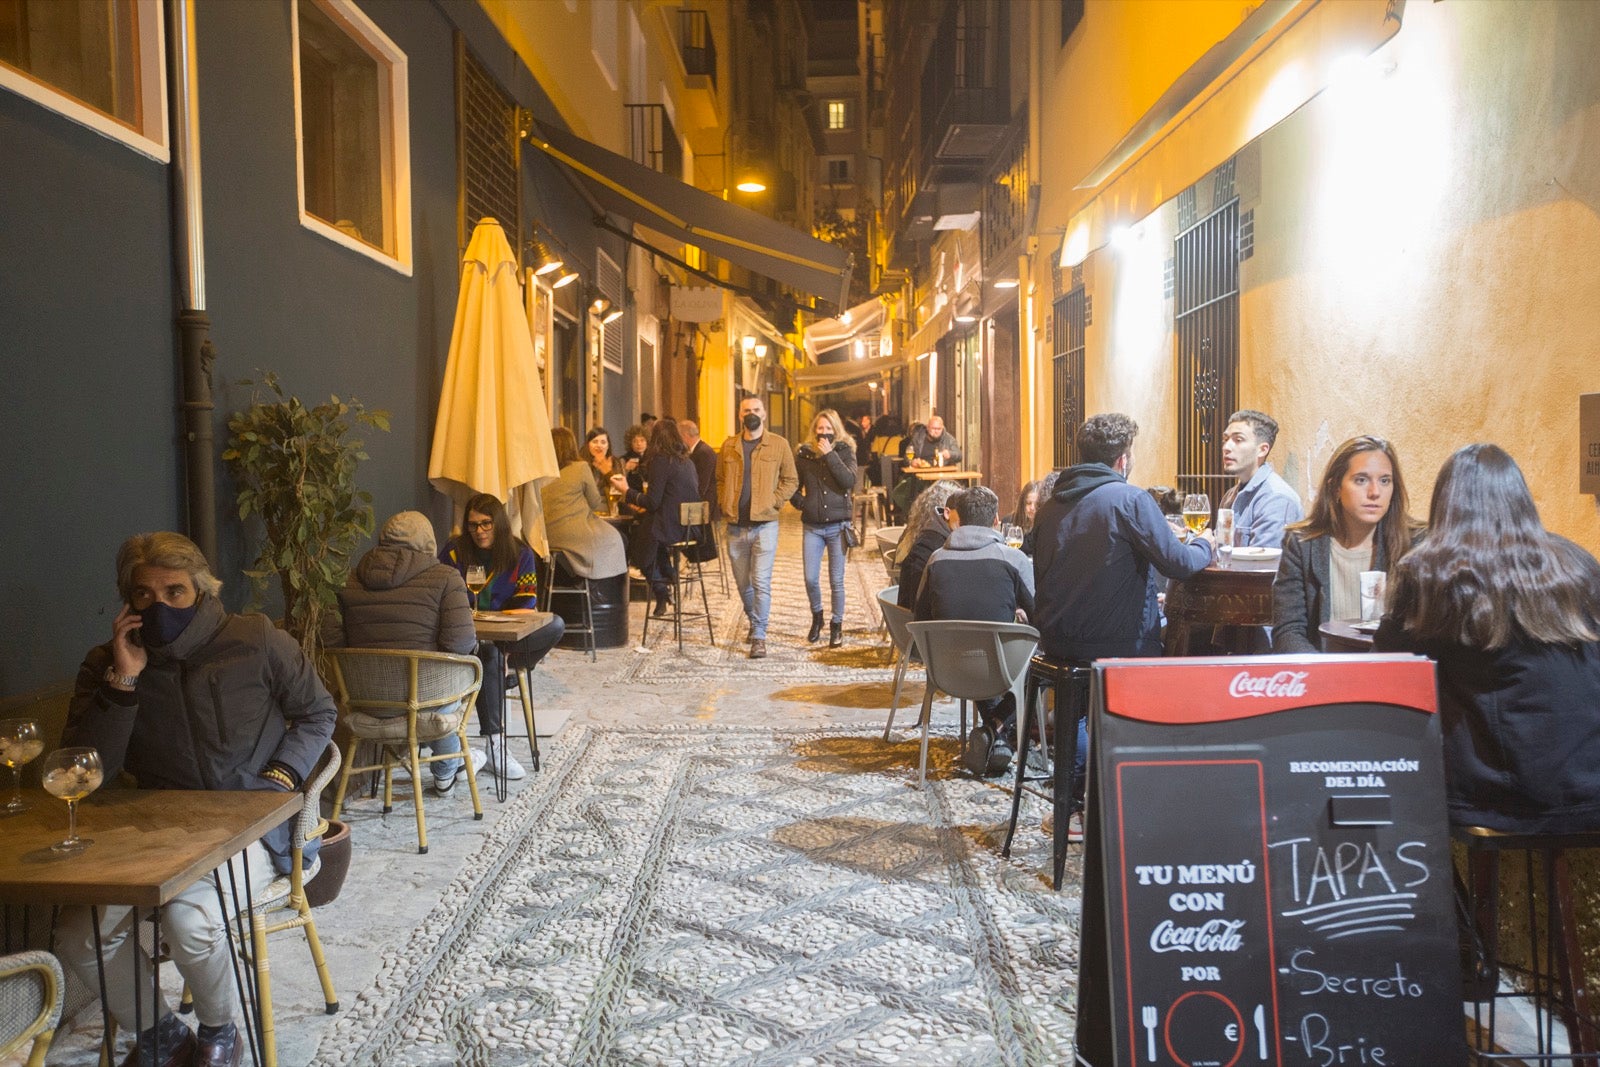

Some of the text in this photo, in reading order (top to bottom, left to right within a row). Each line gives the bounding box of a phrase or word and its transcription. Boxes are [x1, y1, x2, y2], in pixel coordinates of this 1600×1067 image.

[1229, 671, 1309, 698] Coca-Cola
[1289, 758, 1419, 773] RECOMENDACIÓN
[1325, 774, 1386, 788] DEL DÍA
[1135, 859, 1256, 886] TU MENÚ
[1267, 837, 1430, 906] TAPAS
[1169, 892, 1225, 912] CON
[1150, 919, 1247, 953] Coca-Cola
[1181, 966, 1221, 982] POR
[1224, 1023, 1239, 1042] €
